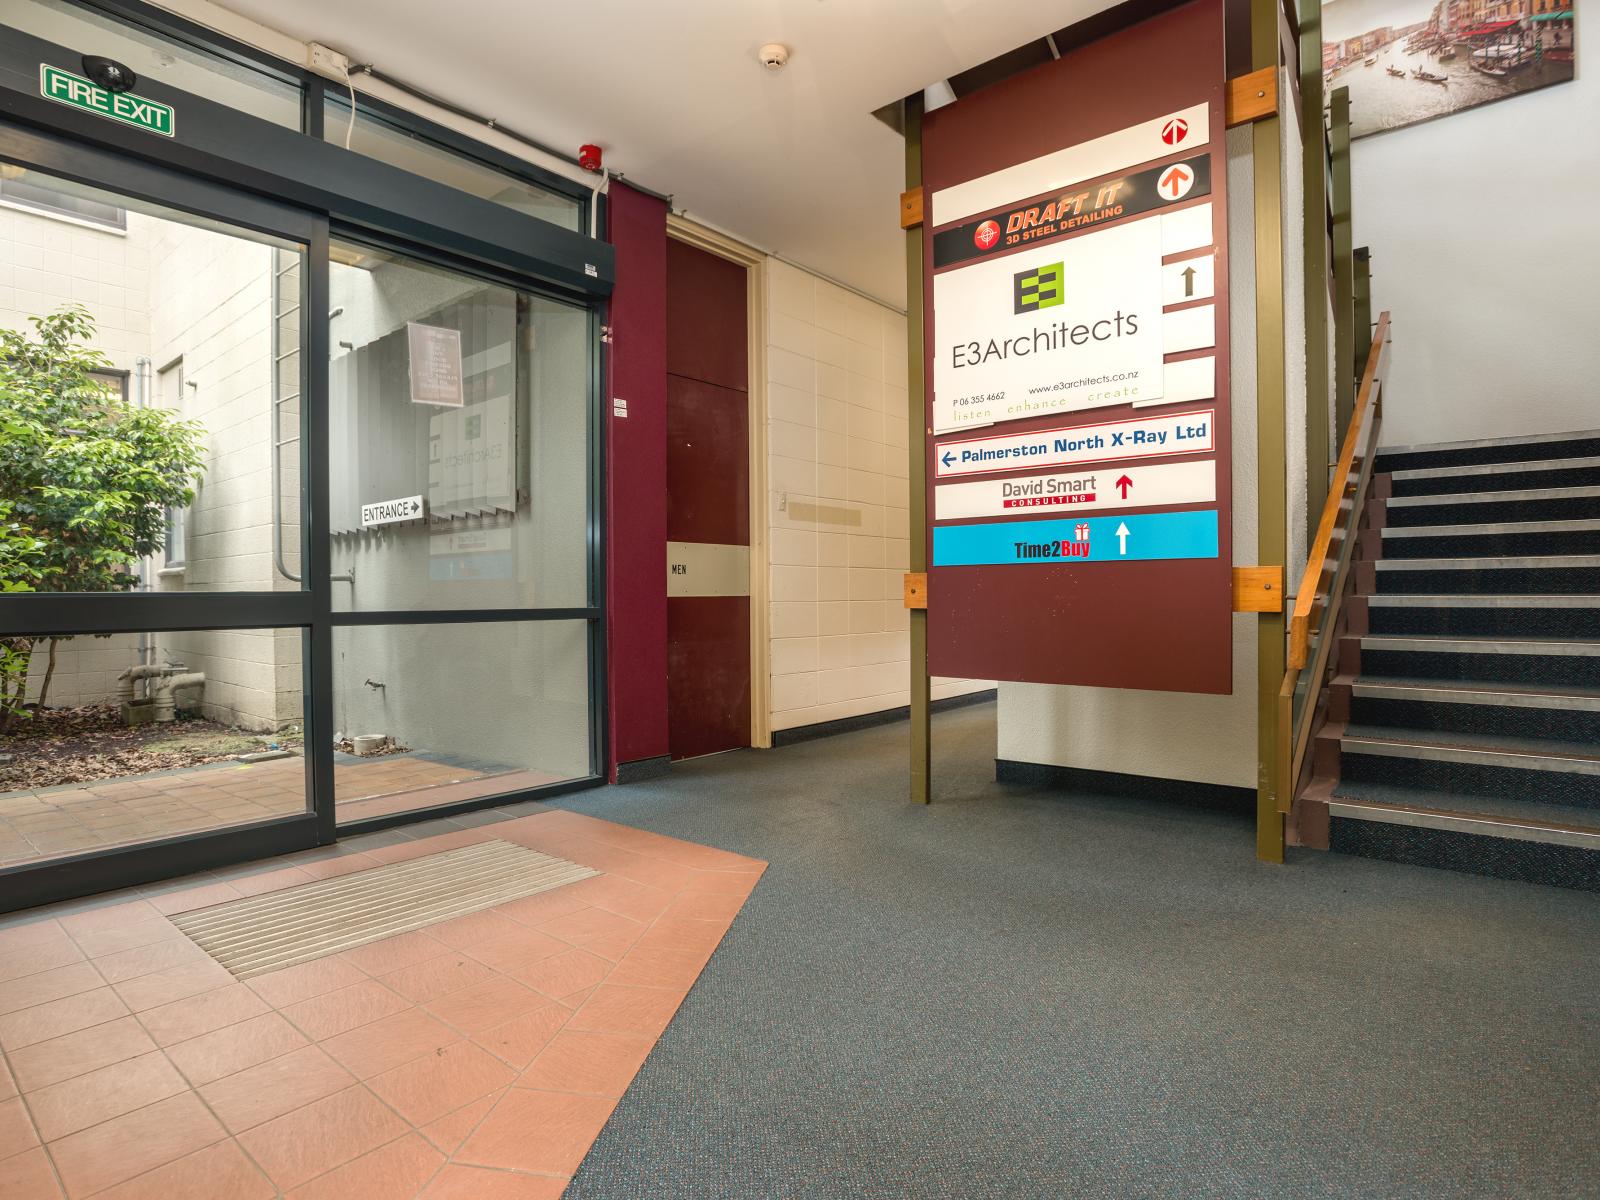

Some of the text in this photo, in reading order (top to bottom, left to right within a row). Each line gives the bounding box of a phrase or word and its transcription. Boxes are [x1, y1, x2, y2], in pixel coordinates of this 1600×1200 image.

[51, 73, 167, 128] FIRE EXIT
[1006, 182, 1123, 234] DRAFT IT
[1006, 205, 1123, 246] 3D STEEL DETAILING
[952, 310, 1139, 369] E3Architects
[1028, 370, 1139, 395] www.e3architects.co.nz
[953, 391, 1006, 407] P 06 355 4662
[953, 386, 1139, 422] listen enhance create
[961, 422, 1207, 463] Palmerston North X-Ray Ltd
[1002, 476, 1096, 497] David Smart
[364, 501, 409, 522] ENTRANCE
[1011, 495, 1086, 507] CONSULTING
[1014, 540, 1090, 558] Time2Buy
[672, 564, 686, 575] MEN
